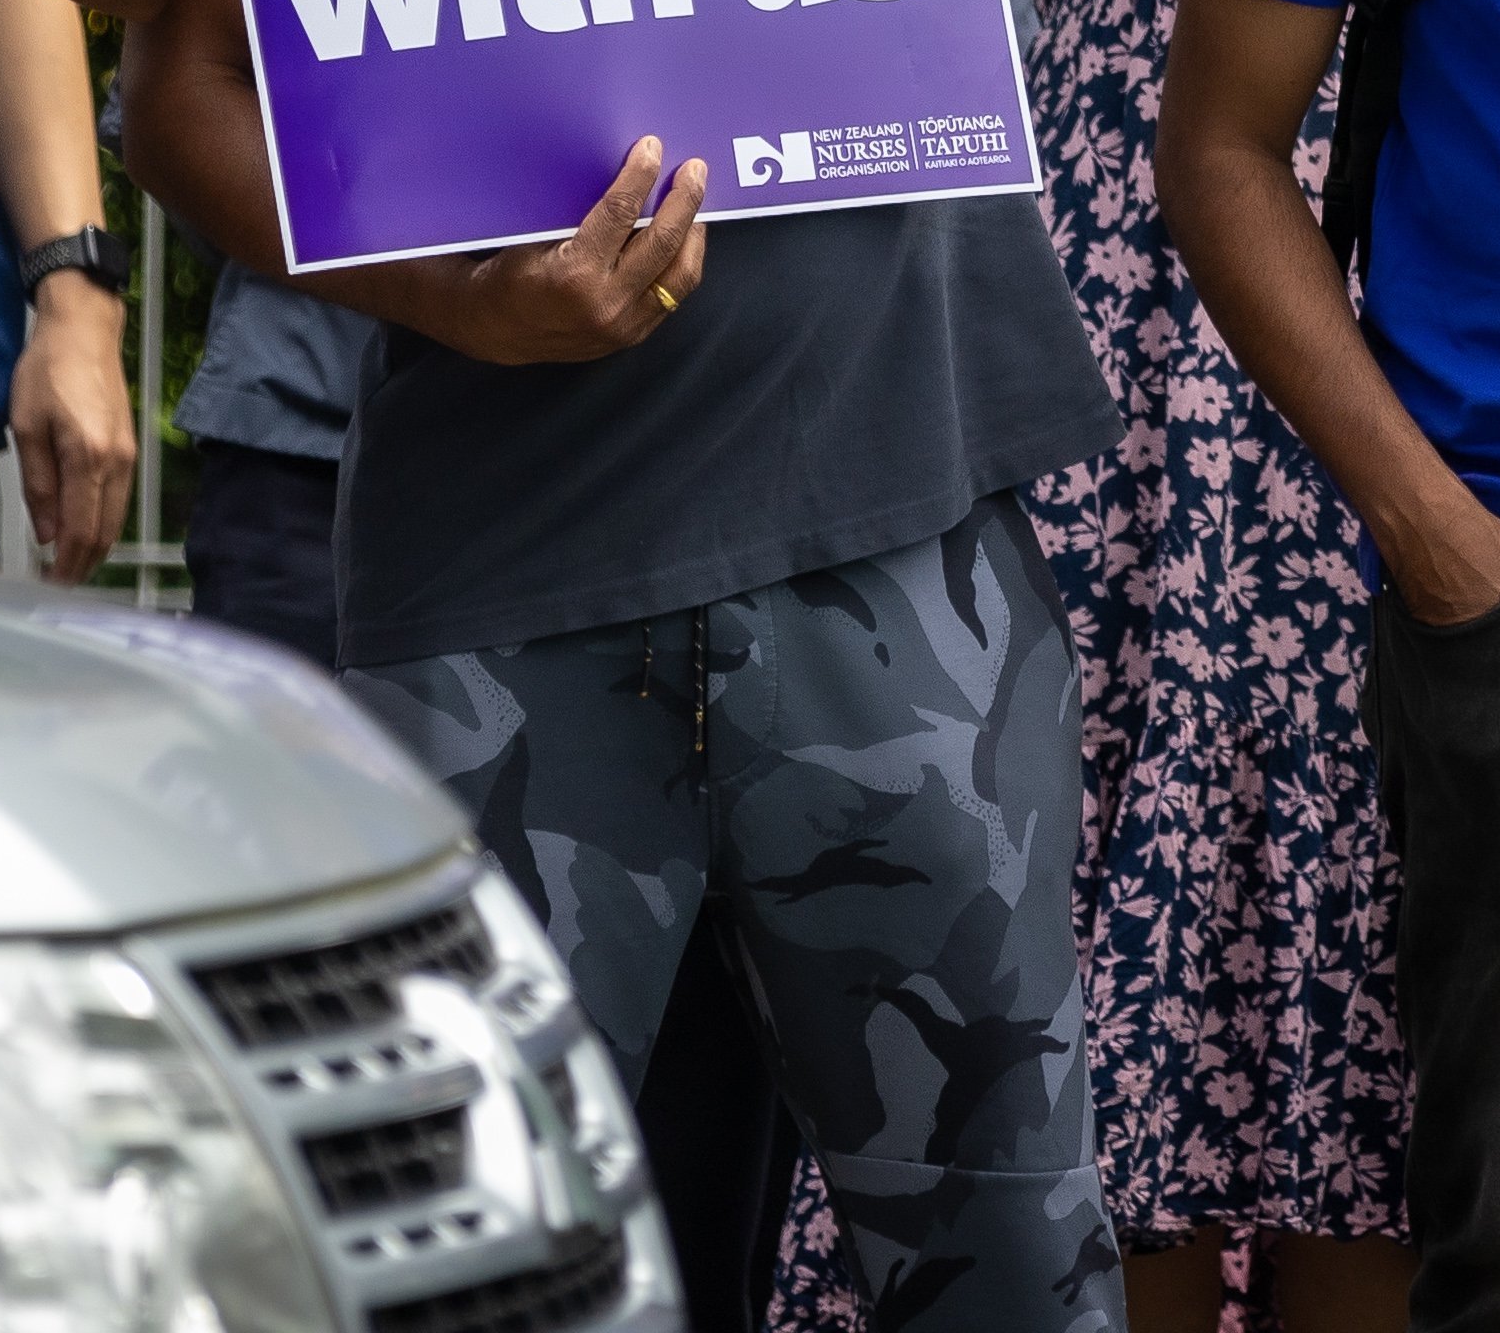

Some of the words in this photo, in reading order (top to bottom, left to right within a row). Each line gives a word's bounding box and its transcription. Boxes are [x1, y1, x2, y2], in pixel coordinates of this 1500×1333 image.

[812, 128, 842, 143] NEW
[845, 122, 903, 140] ZEALAND
[917, 114, 1005, 135] TŌPŪTANGA
[816, 138, 907, 165] NURSES
[920, 132, 1010, 157] TAPUHI
[819, 160, 910, 180] ORGANISATION
[959, 158, 967, 166] O
[967, 154, 1011, 167] AOTEAROA
